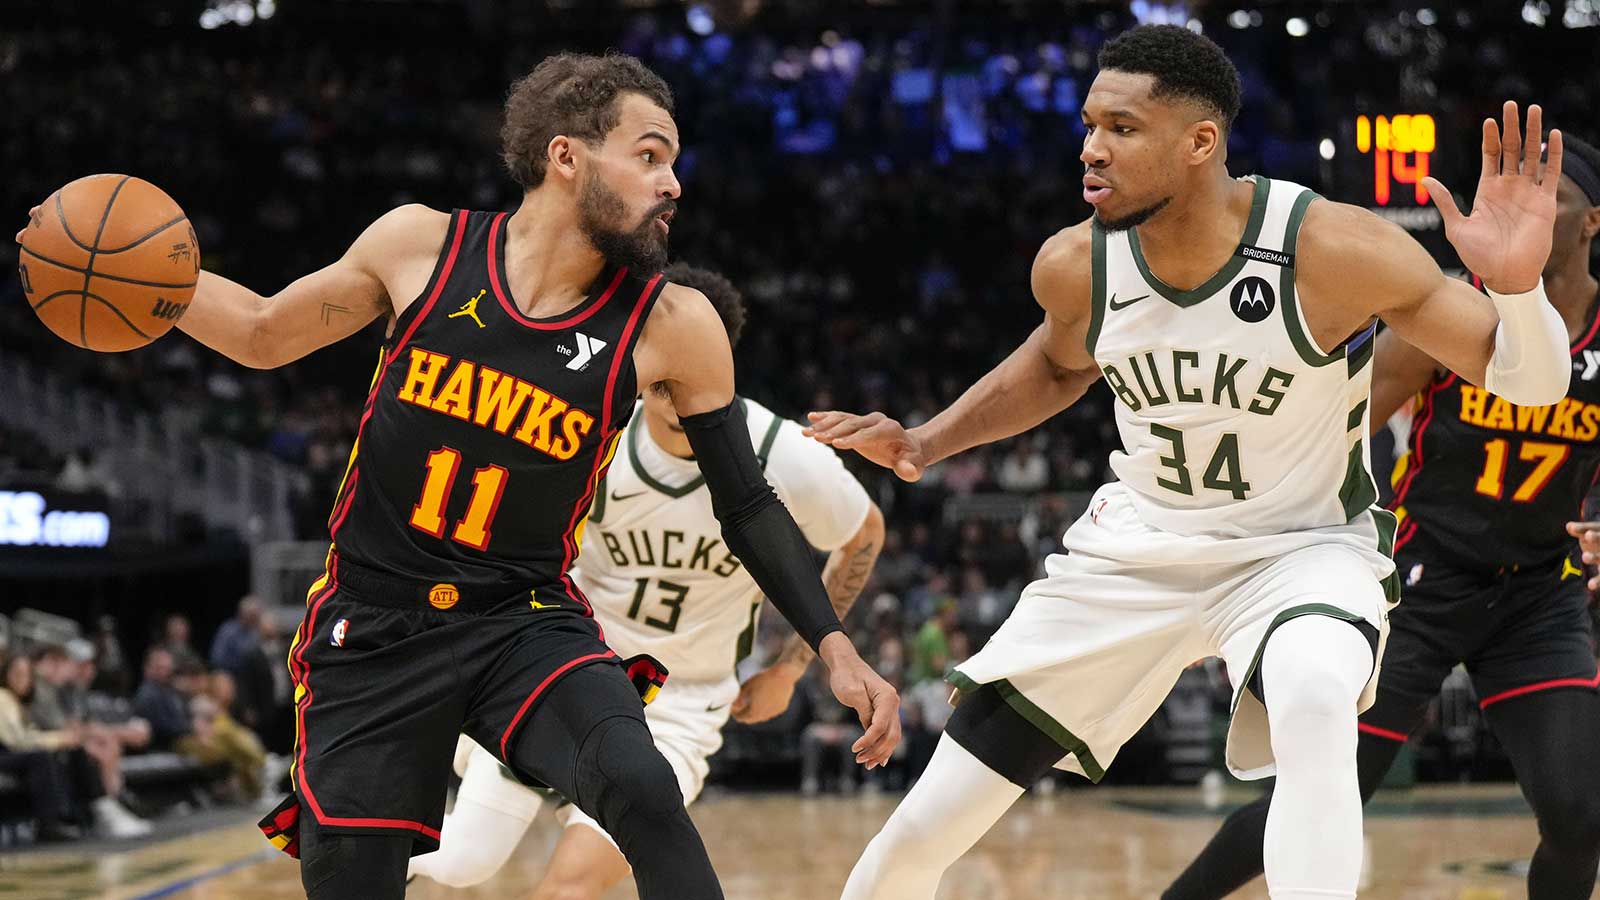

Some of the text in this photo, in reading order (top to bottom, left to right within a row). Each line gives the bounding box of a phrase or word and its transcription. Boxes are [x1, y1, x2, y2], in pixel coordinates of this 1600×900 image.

[1242, 246, 1290, 265] BRIDGEMAN
[556, 344, 572, 357] the
[397, 347, 595, 461] HAWKS
[1103, 350, 1295, 416] BUCKS
[1459, 385, 1600, 443] HAWKS
[1150, 422, 1251, 501] 34
[1475, 437, 1571, 504] 17
[408, 445, 510, 552] 11
[601, 529, 741, 578] BUCKS
[432, 590, 456, 602] ATL
[627, 576, 690, 634] 13
